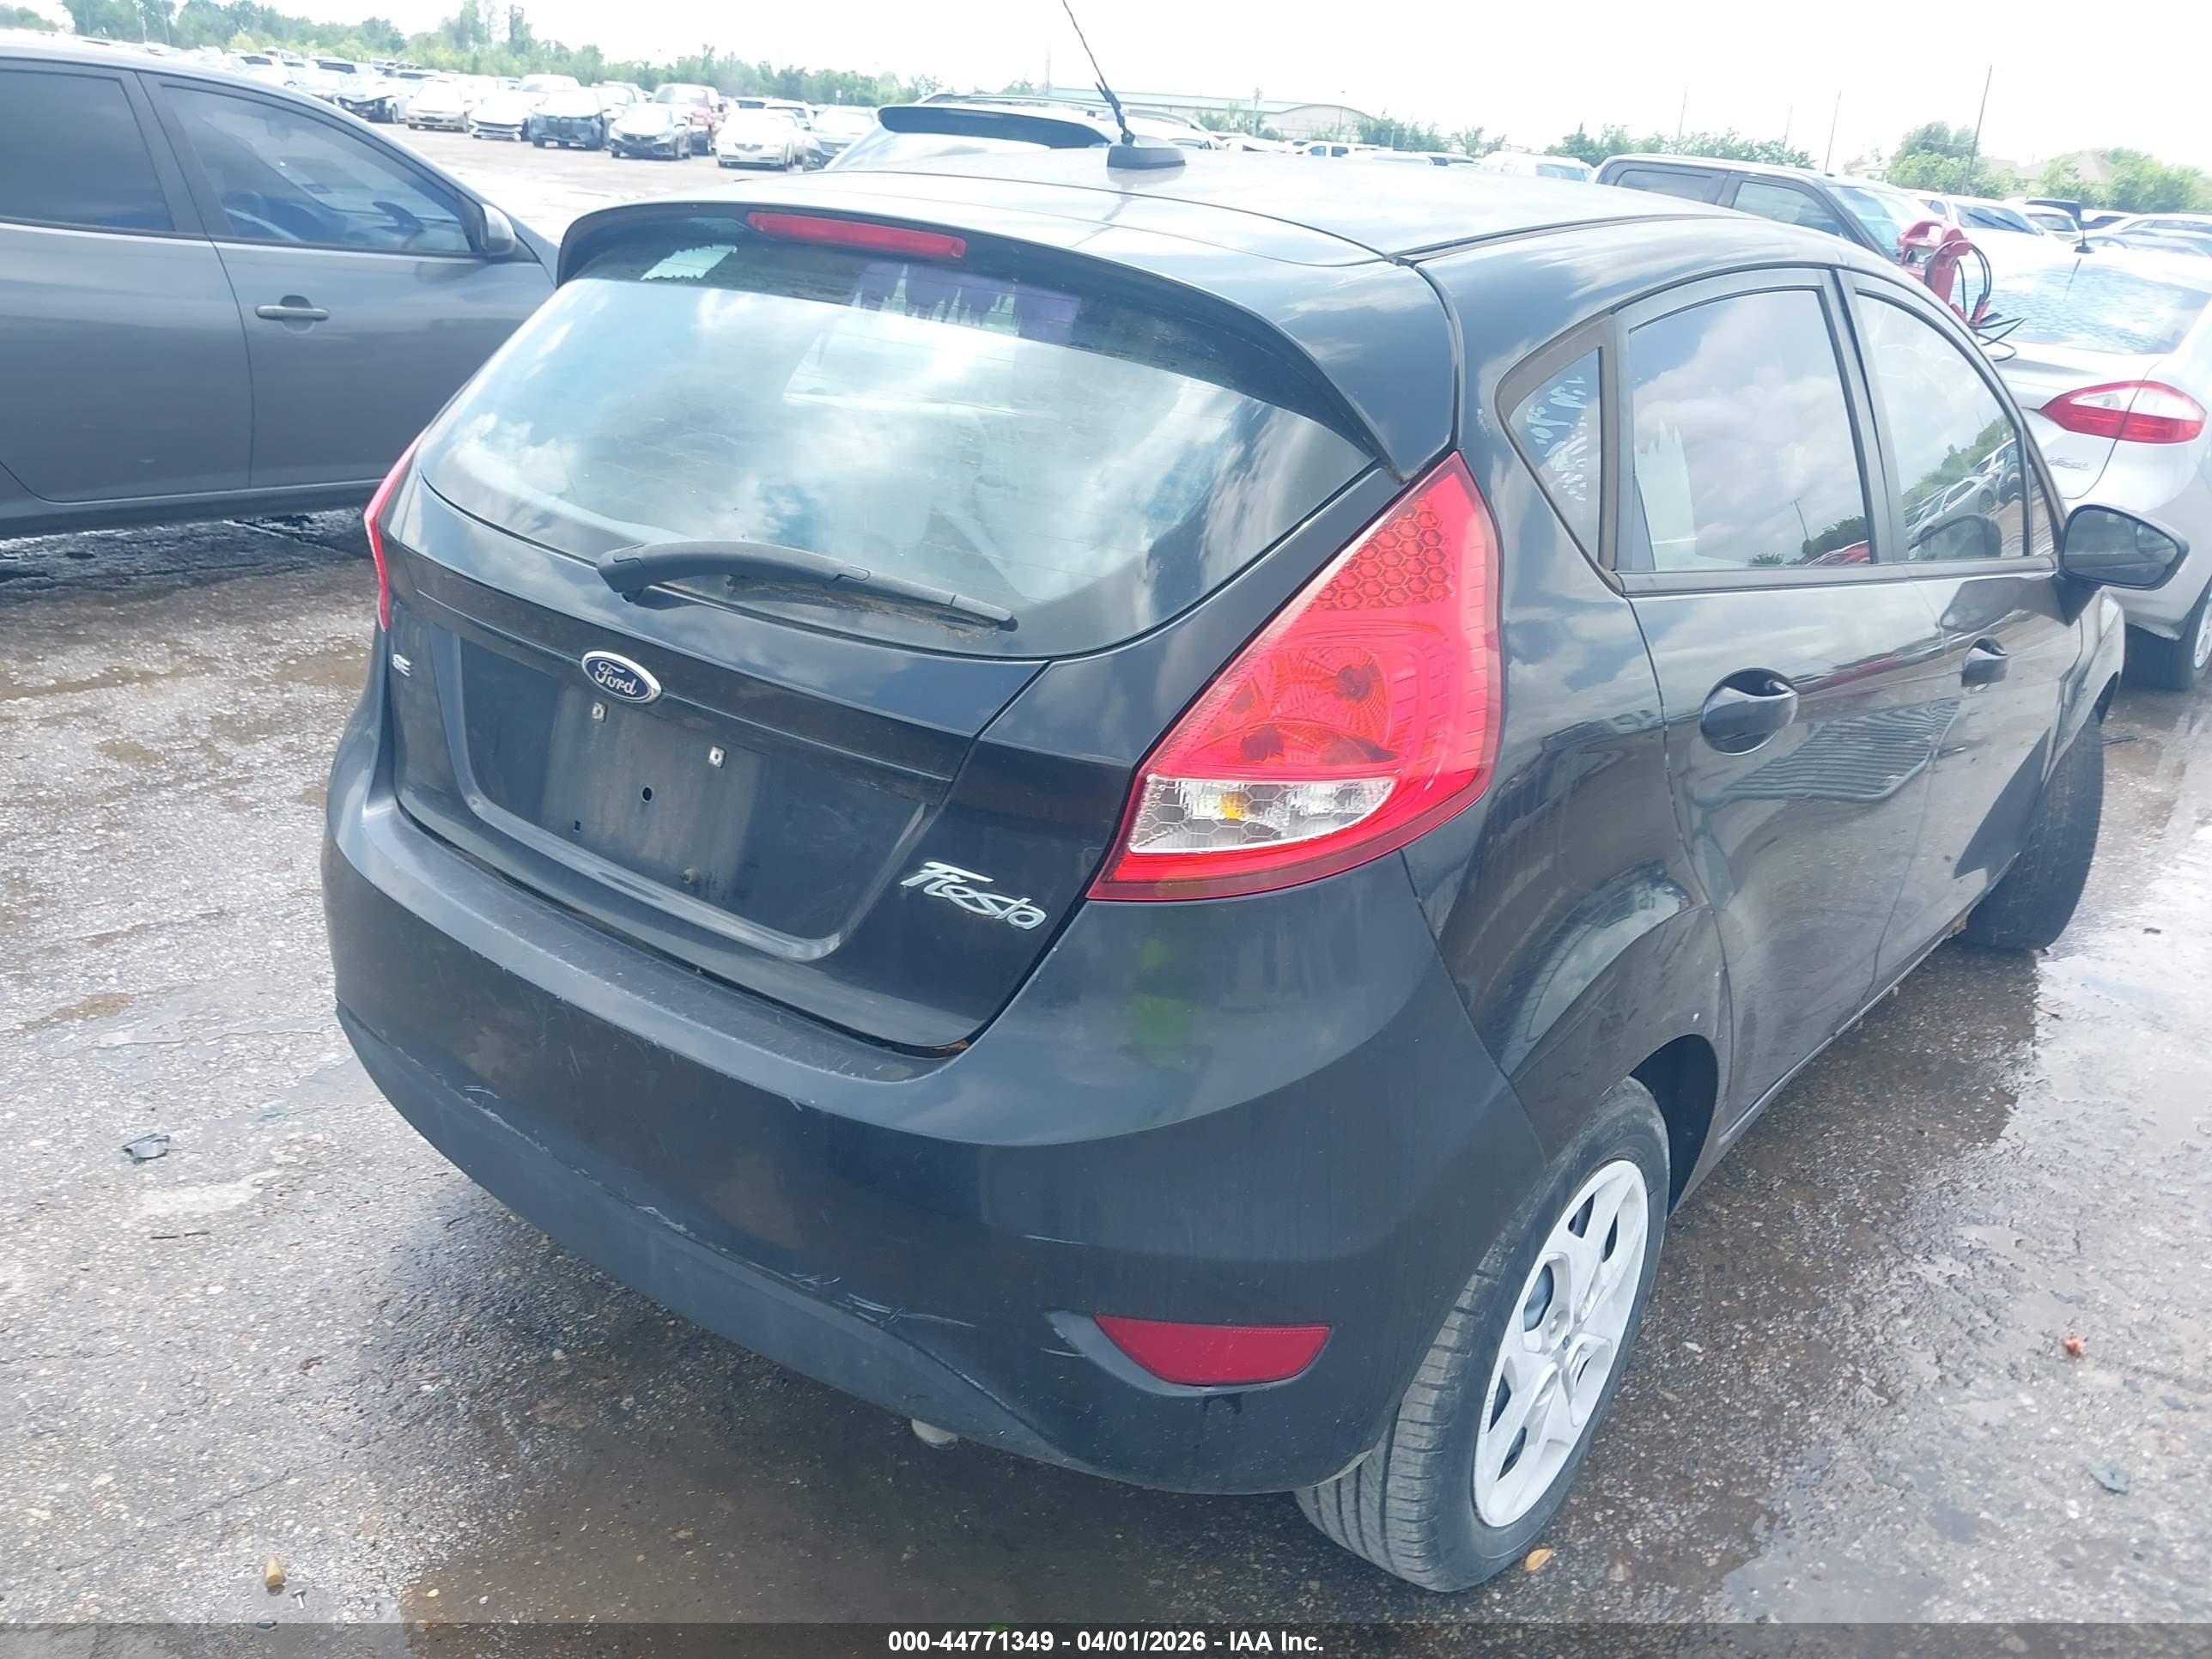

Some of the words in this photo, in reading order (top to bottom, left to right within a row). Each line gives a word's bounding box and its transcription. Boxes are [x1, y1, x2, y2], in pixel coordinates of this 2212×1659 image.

[392, 653, 411, 677] SE
[595, 661, 637, 695] Ford
[900, 861, 1047, 929] Fiesta
